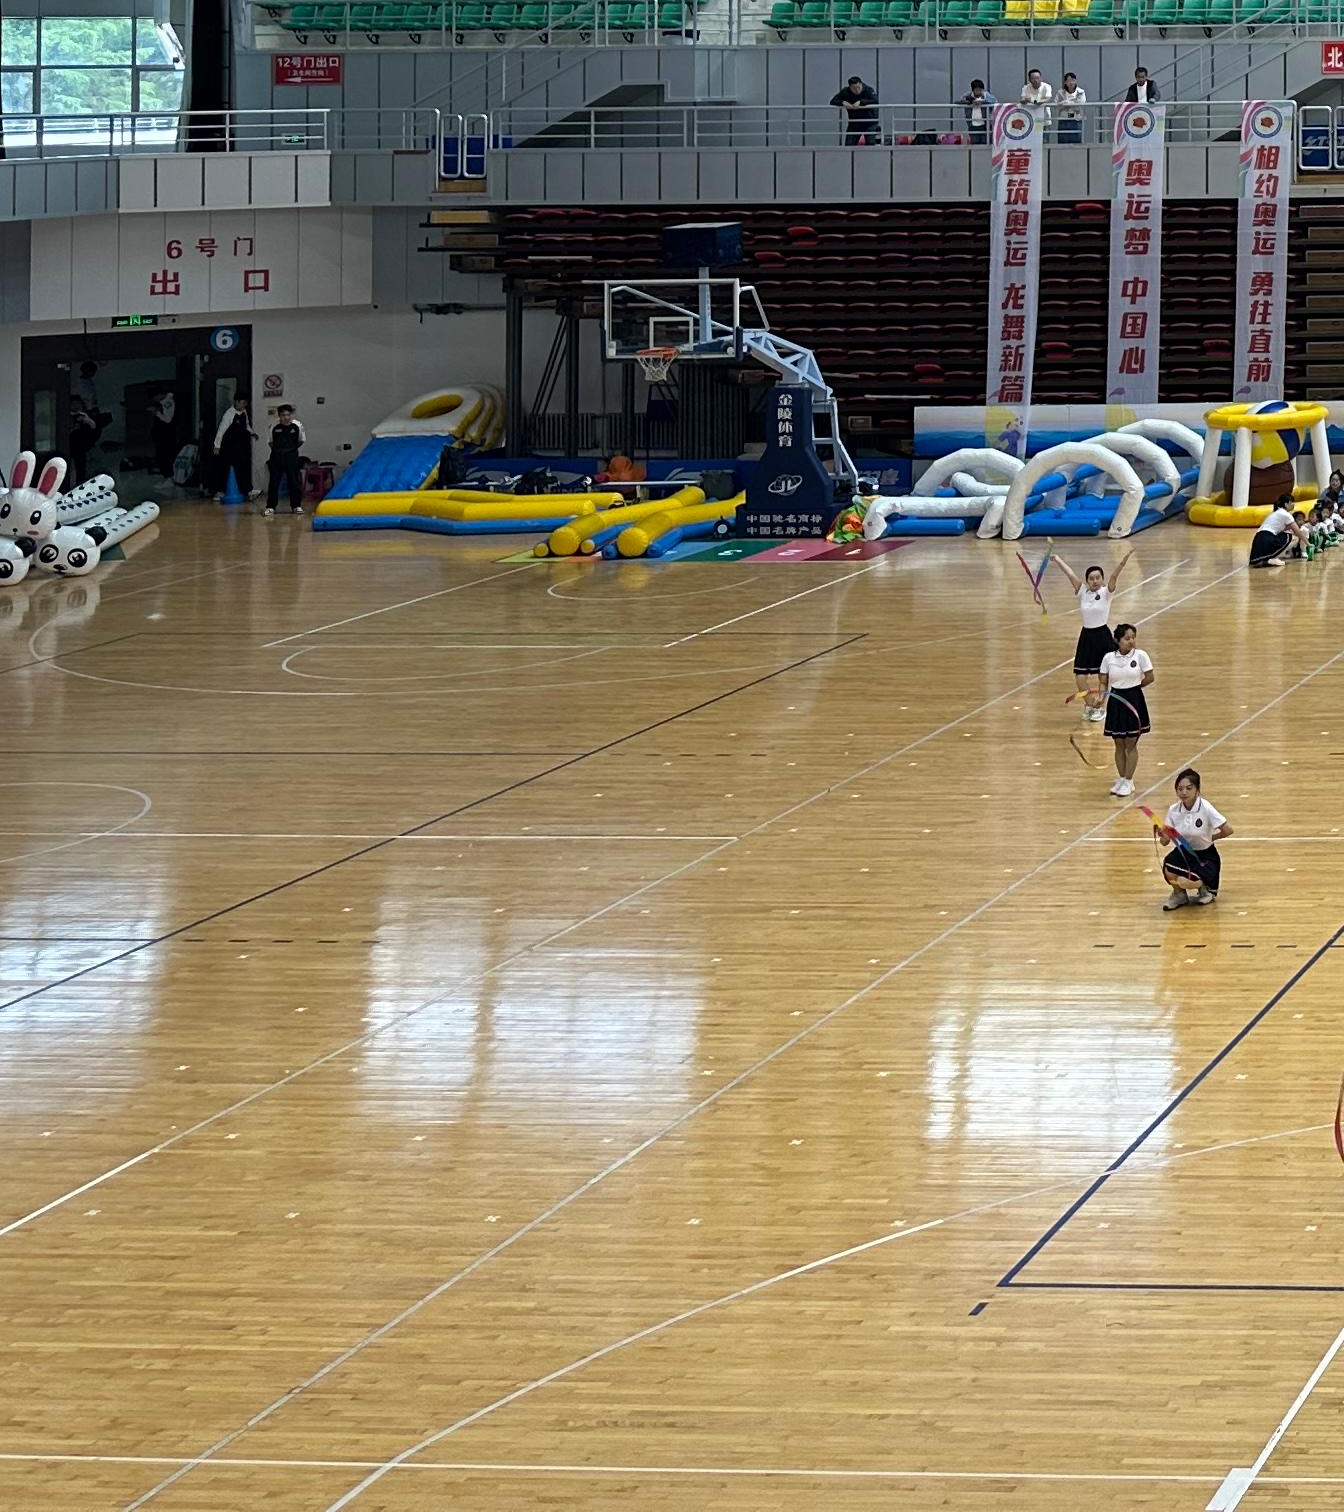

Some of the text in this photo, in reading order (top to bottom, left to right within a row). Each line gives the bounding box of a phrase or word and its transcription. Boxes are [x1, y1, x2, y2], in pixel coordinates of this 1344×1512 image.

[277, 56, 339, 68] 12号门出口
[166, 236, 253, 259] 6号门
[1004, 148, 1031, 267] 童筑奥运
[1123, 158, 1153, 255] 奥运梦
[1252, 145, 1280, 256] 相约奥运
[150, 269, 269, 296] 出口
[1119, 277, 1149, 374] 中国心
[1246, 272, 1274, 382] 勇往直前
[215, 329, 233, 349] 6
[998, 283, 1027, 403] 龙舞新篇
[777, 394, 793, 447] 金陵体育
